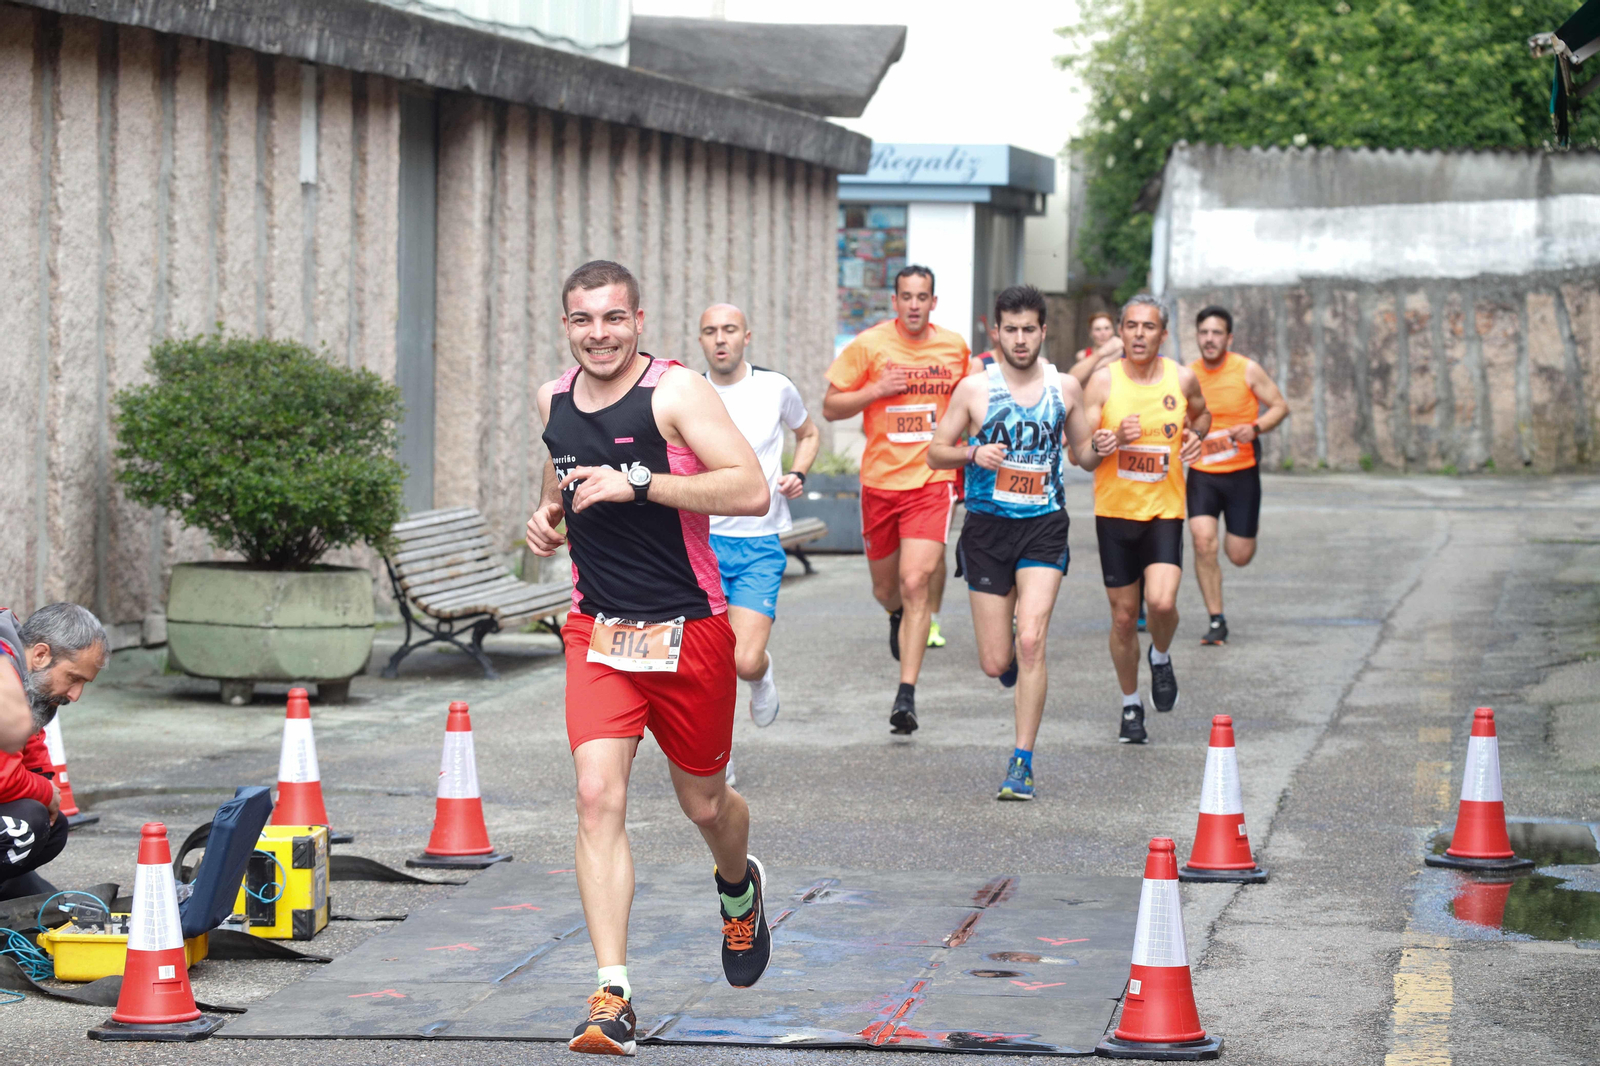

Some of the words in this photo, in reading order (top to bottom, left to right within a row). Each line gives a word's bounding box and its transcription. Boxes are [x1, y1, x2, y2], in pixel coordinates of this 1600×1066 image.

[869, 145, 983, 184] Regaliz
[898, 381, 951, 395] ondariz
[896, 416, 923, 433] 823
[989, 421, 1063, 451] ADN
[1127, 456, 1155, 473] 240
[1009, 474, 1035, 494] 231
[610, 631, 649, 657] 914
